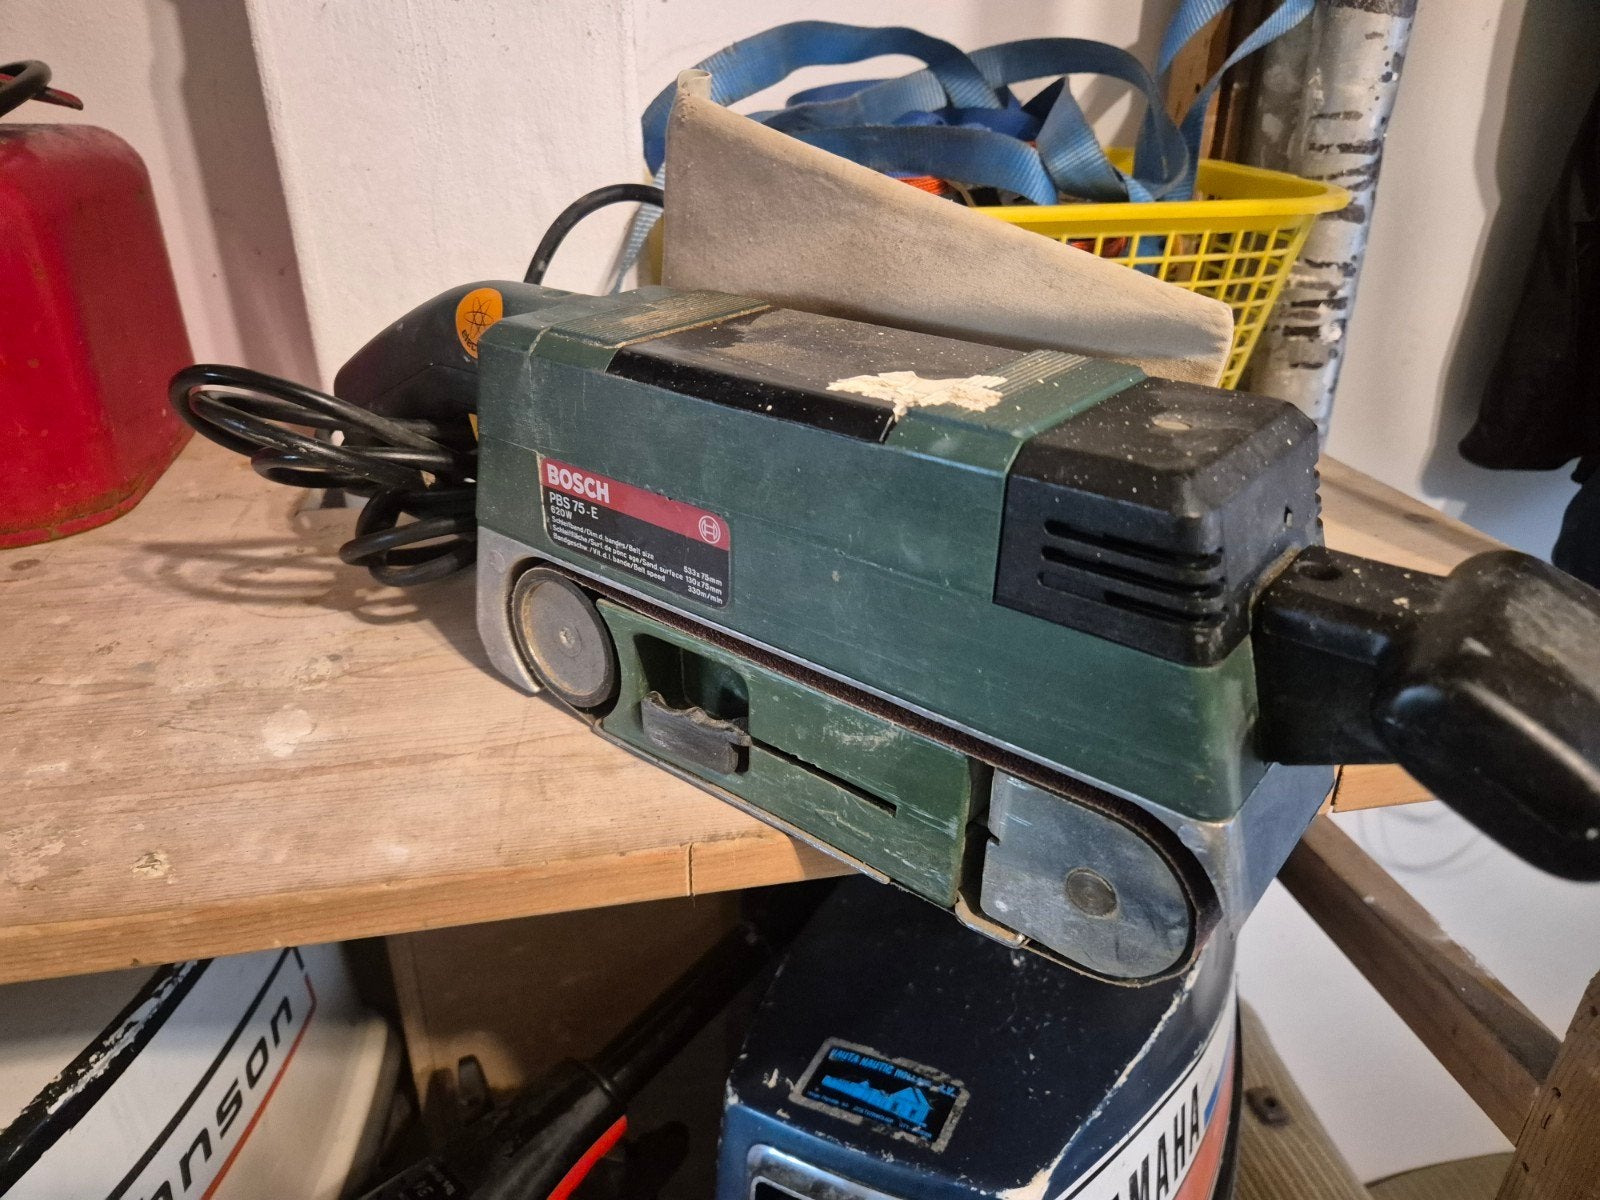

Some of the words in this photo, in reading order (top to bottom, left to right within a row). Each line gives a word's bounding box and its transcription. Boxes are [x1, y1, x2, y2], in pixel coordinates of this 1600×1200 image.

[547, 463, 610, 504] BOSCH
[549, 491, 571, 509] PBS
[550, 505, 572, 520] 620W
[642, 550, 655, 560] size
[659, 566, 683, 581] surface
[646, 570, 666, 583] speed
[687, 585, 723, 605] 330m/min
[1112, 1082, 1200, 1200] MAHA
